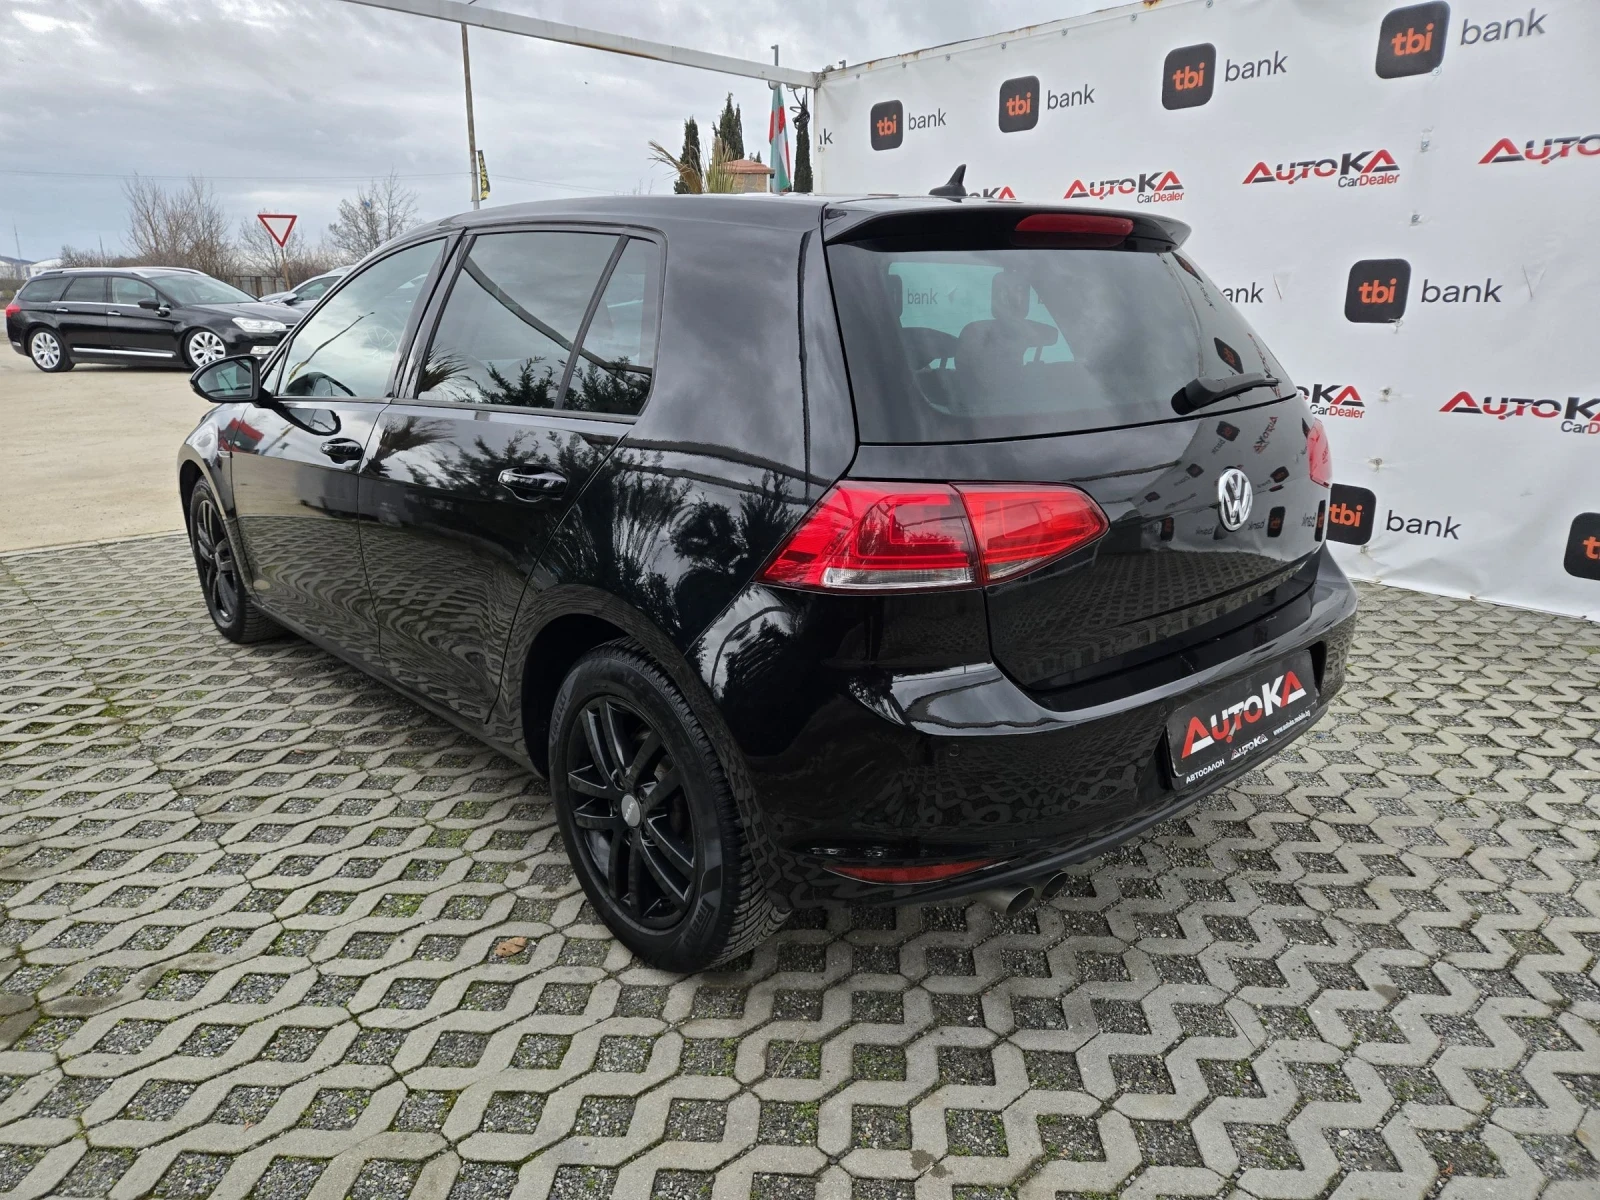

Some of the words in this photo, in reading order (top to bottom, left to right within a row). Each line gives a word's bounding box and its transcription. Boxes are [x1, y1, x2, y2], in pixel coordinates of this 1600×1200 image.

[1391, 22, 1435, 58] tbi
[1460, 8, 1549, 46] bank
[1172, 62, 1206, 92] tbi
[1224, 51, 1289, 83] bank
[1006, 91, 1032, 117] tbi
[1046, 83, 1096, 111] bank
[876, 114, 898, 136] tbi
[907, 108, 947, 132] bank
[1241, 148, 1401, 185] AUTOKA
[1337, 172, 1401, 189] CarDealer
[1062, 170, 1185, 200] AUTOKA
[1136, 191, 1185, 204] CarDealer
[907, 287, 939, 305] bank
[1358, 277, 1398, 305] tbi
[1420, 277, 1504, 304] bank
[1309, 403, 1366, 420] CarDealer
[1438, 390, 1600, 421] AUTOK
[1329, 502, 1363, 528] tbi
[1385, 509, 1463, 541] bank
[1181, 670, 1307, 759] AUTOKA
